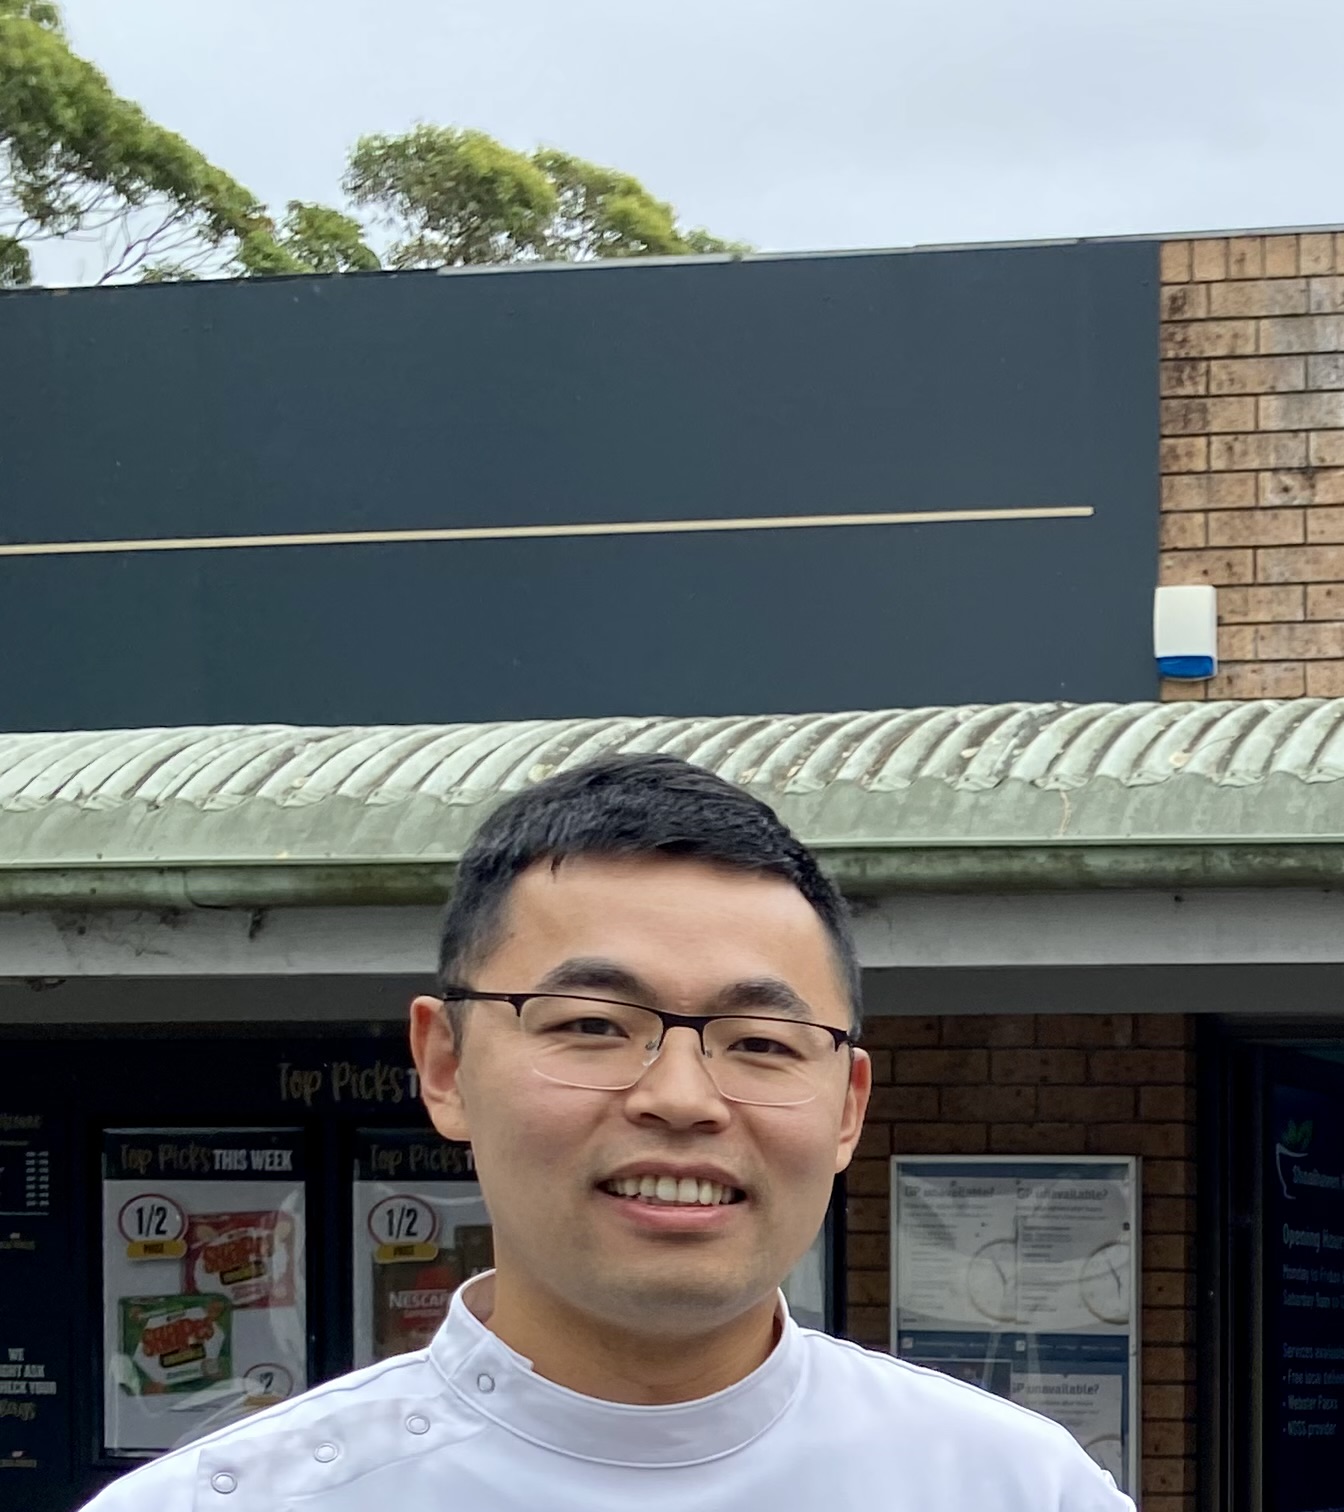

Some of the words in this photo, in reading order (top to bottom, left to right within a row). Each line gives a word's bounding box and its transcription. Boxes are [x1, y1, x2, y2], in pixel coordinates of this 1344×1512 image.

[279, 1062, 322, 1107] Top
[213, 1148, 248, 1171] THIS
[250, 1149, 294, 1172] WEEK
[135, 1204, 168, 1238] 1/2
[386, 1204, 418, 1240] 1/2
[388, 1289, 451, 1309] NESCAF
[1026, 1382, 1099, 1396] unavailable?
